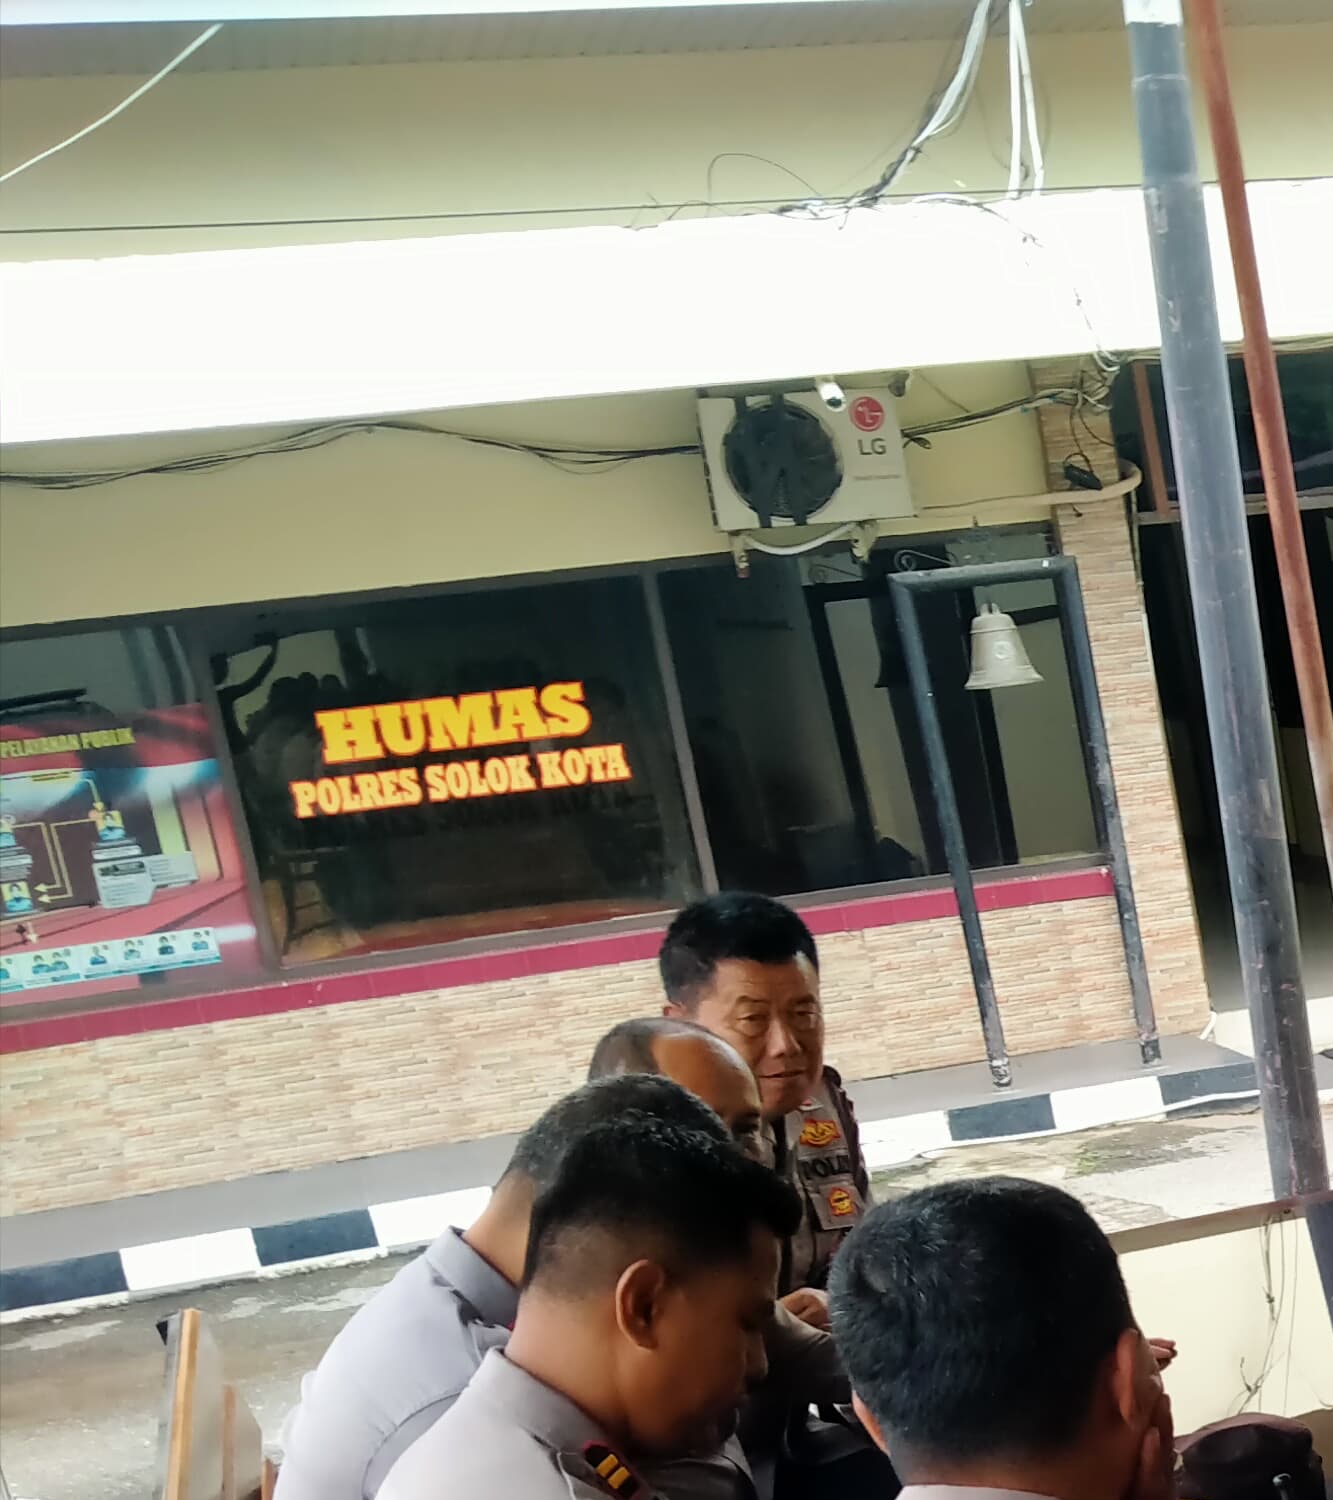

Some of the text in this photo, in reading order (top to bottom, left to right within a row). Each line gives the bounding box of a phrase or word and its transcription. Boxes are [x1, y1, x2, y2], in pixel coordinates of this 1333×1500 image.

[858, 437, 887, 456] LG
[314, 681, 592, 764] HUMAS
[288, 743, 632, 819] POLRES SOLOK KOTA
